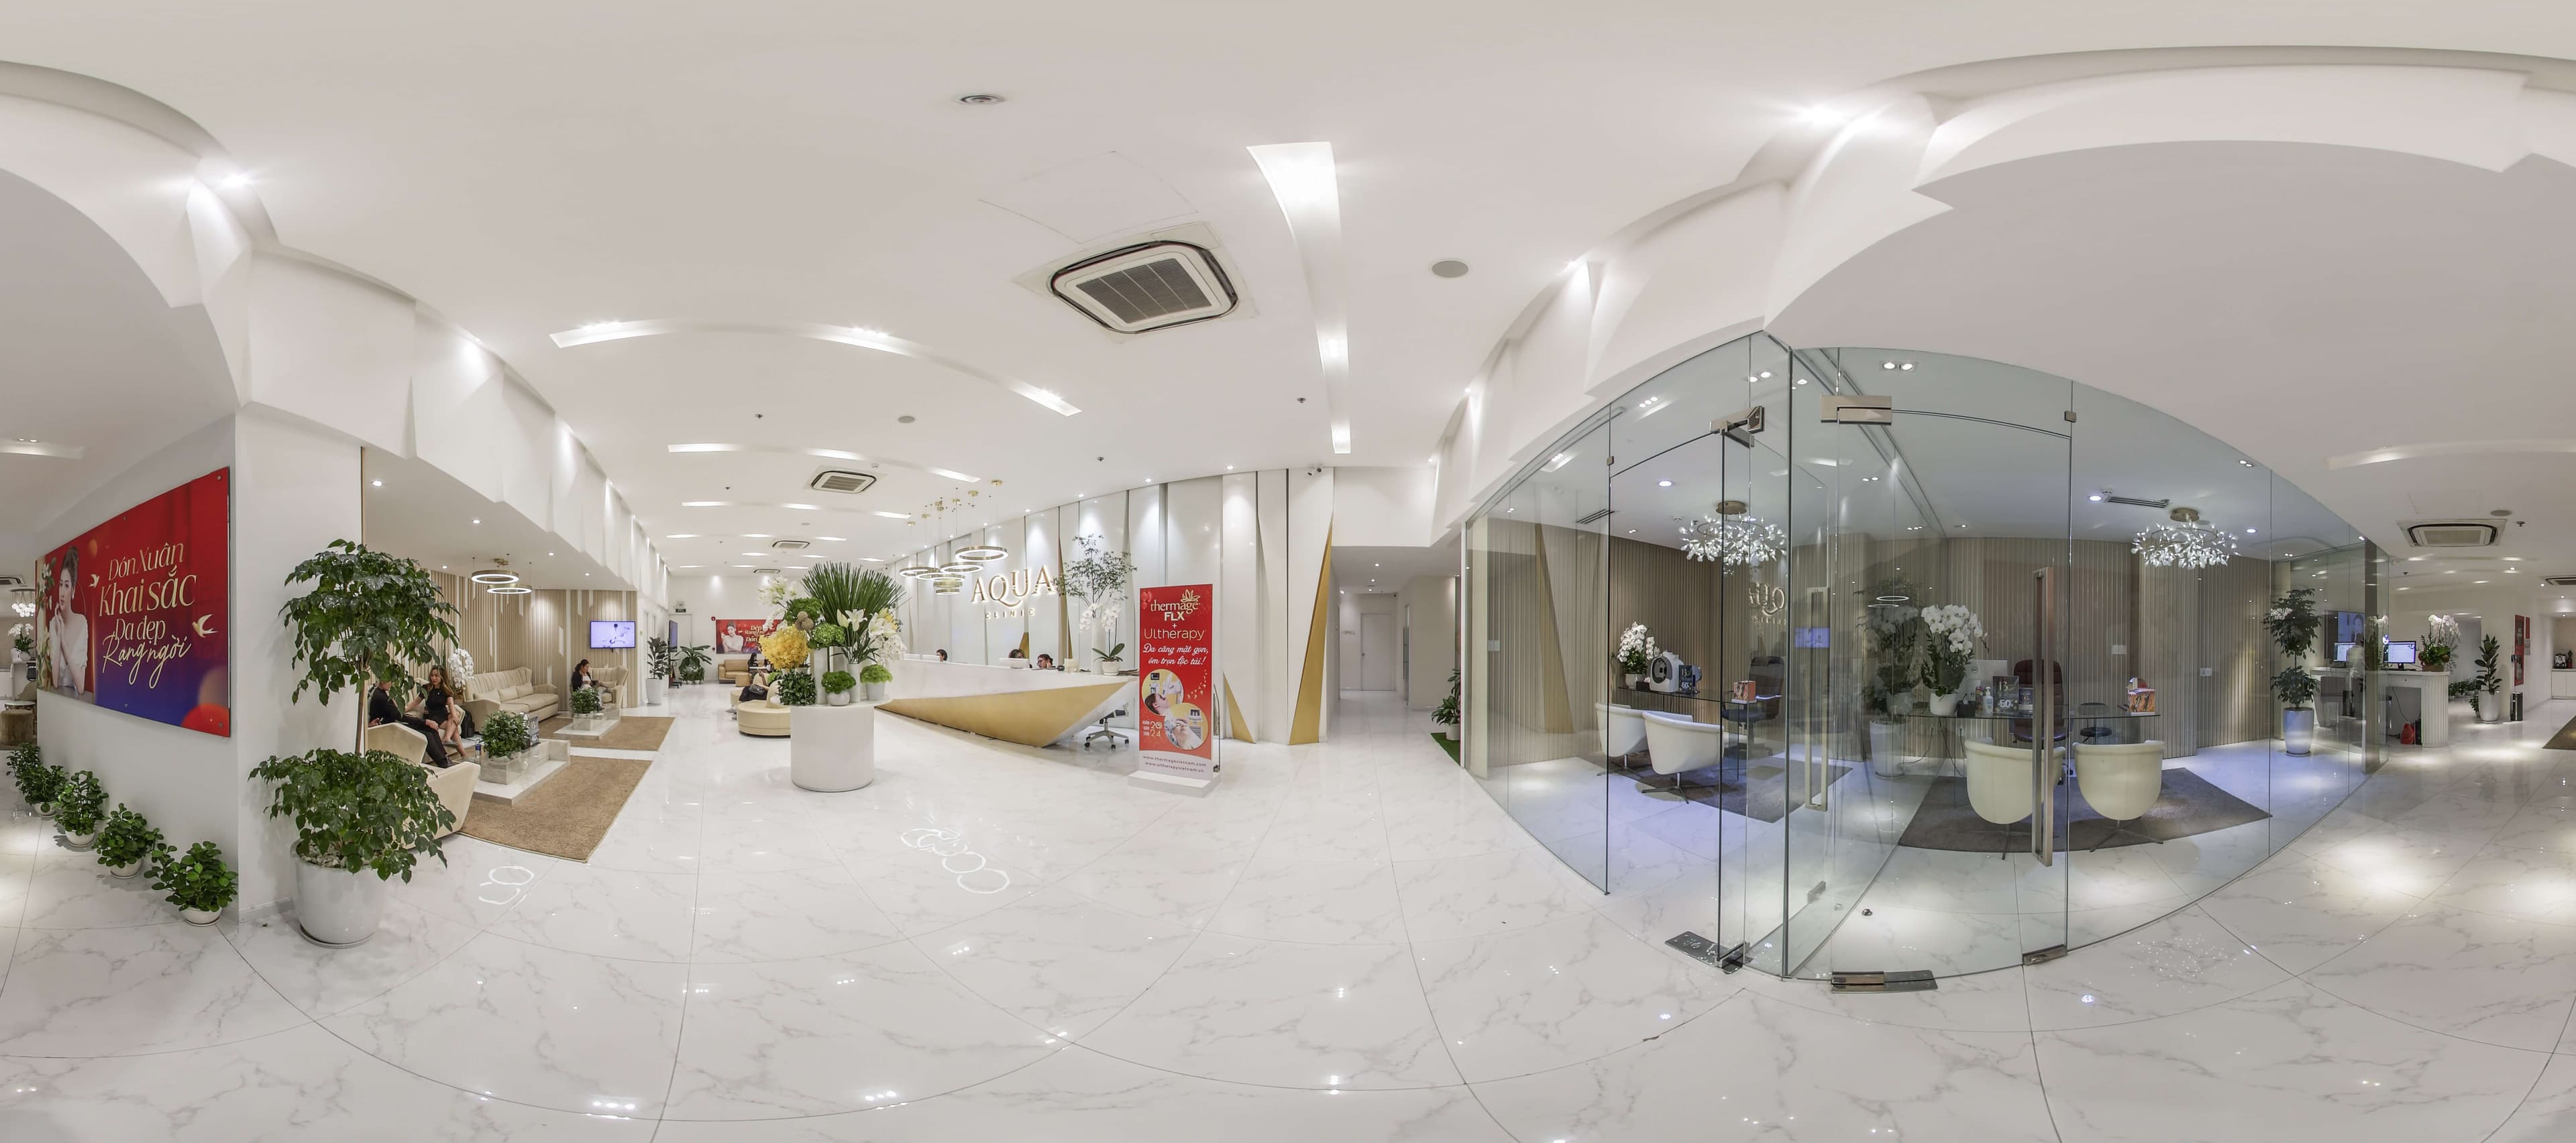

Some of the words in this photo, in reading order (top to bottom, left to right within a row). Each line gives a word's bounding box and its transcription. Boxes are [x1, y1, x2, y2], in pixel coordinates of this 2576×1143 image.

[136, 542, 184, 574] Xuân
[99, 578, 145, 616] Khai
[147, 565, 197, 611] sắc
[971, 565, 1053, 607] AQUA
[985, 609, 1035, 620] CLINIC
[1150, 599, 1198, 614] thermage
[1164, 611, 1185, 621] FLX
[115, 618, 134, 640] Da
[137, 615, 166, 645] đẹp
[1144, 628, 1205, 641] Ultherapy
[1143, 643, 1157, 653] Da
[102, 631, 148, 685] Rạng
[146, 634, 192, 689] ngời
